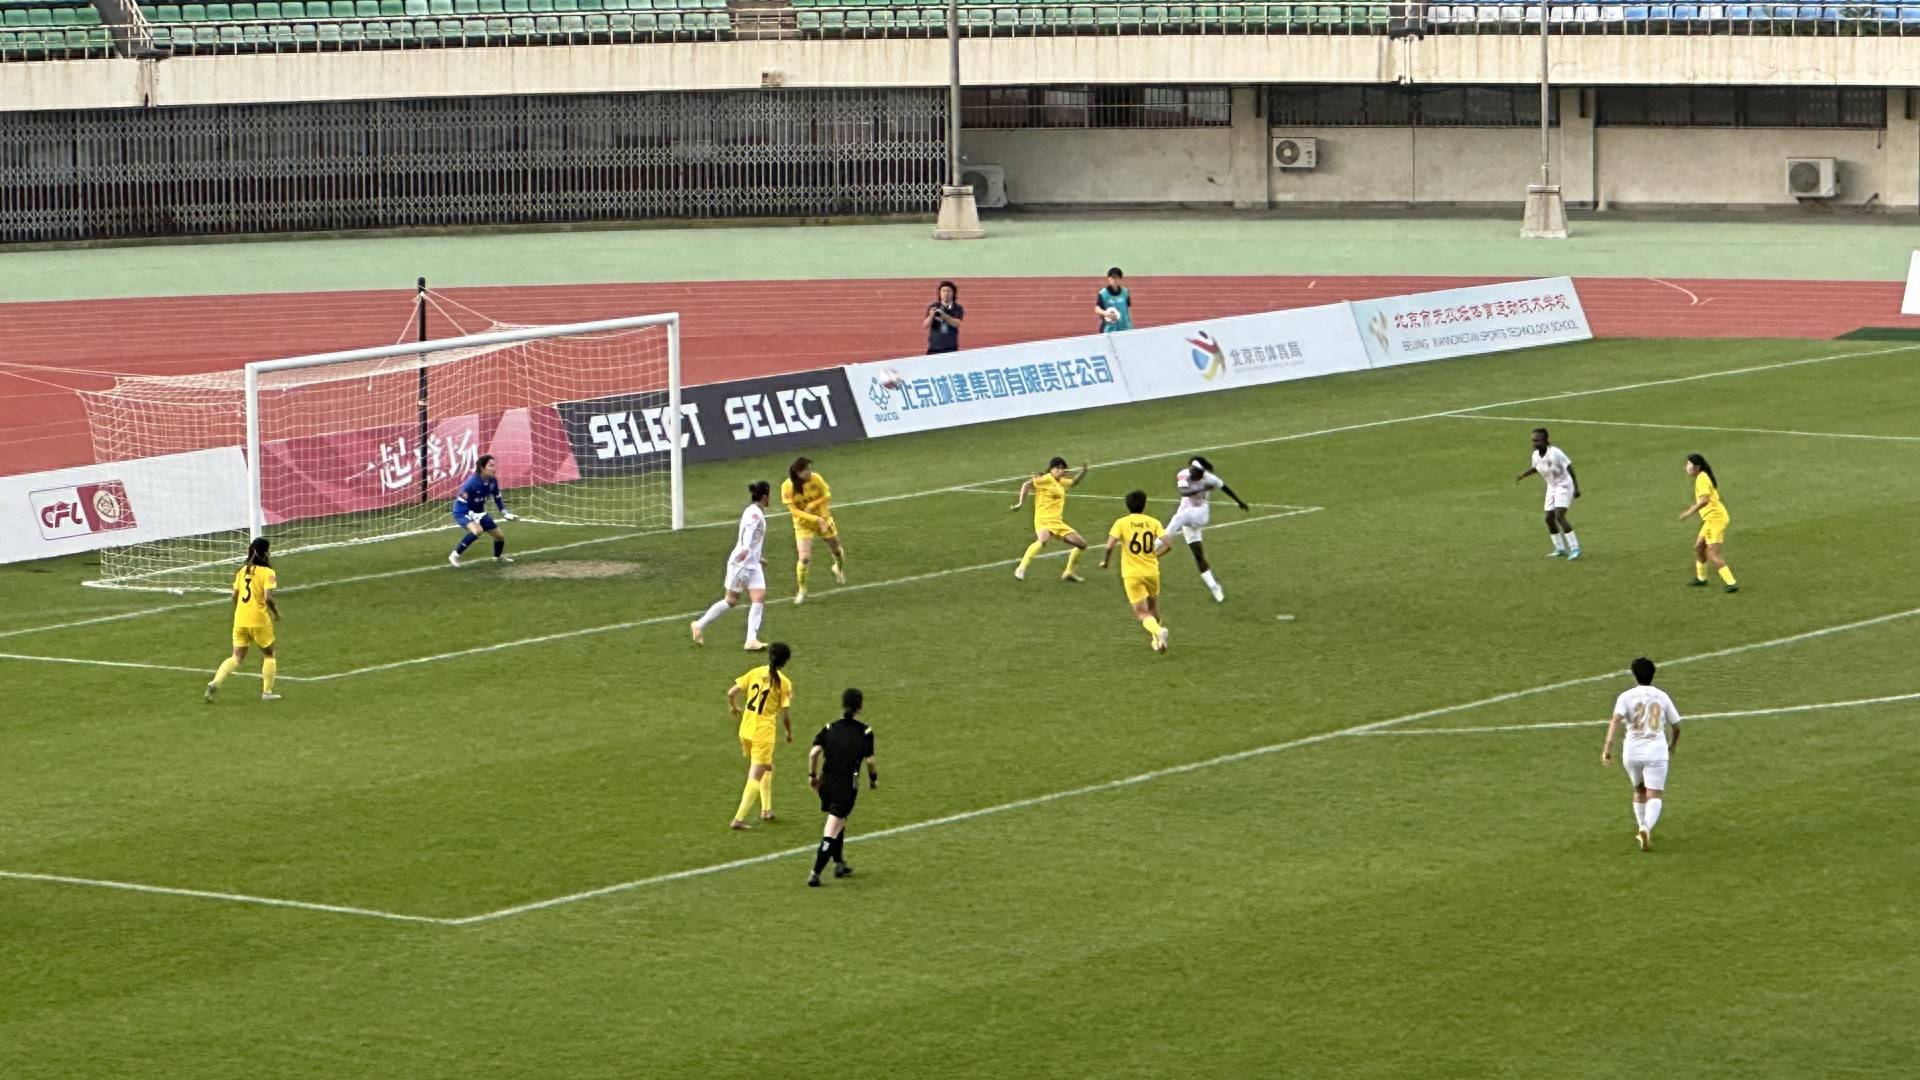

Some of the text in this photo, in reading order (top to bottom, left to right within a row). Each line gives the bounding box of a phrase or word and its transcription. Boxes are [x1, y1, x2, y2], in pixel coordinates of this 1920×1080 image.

[1230, 341, 1303, 366] 北京市体育局
[897, 355, 1114, 410] 北京城建集团有限责任公司
[724, 385, 838, 441] SELECT
[346, 428, 479, 496] 一起登场
[41, 501, 83, 528] CFL
[1130, 531, 1154, 554] 60
[242, 578, 252, 603] 3
[747, 683, 770, 715] 21
